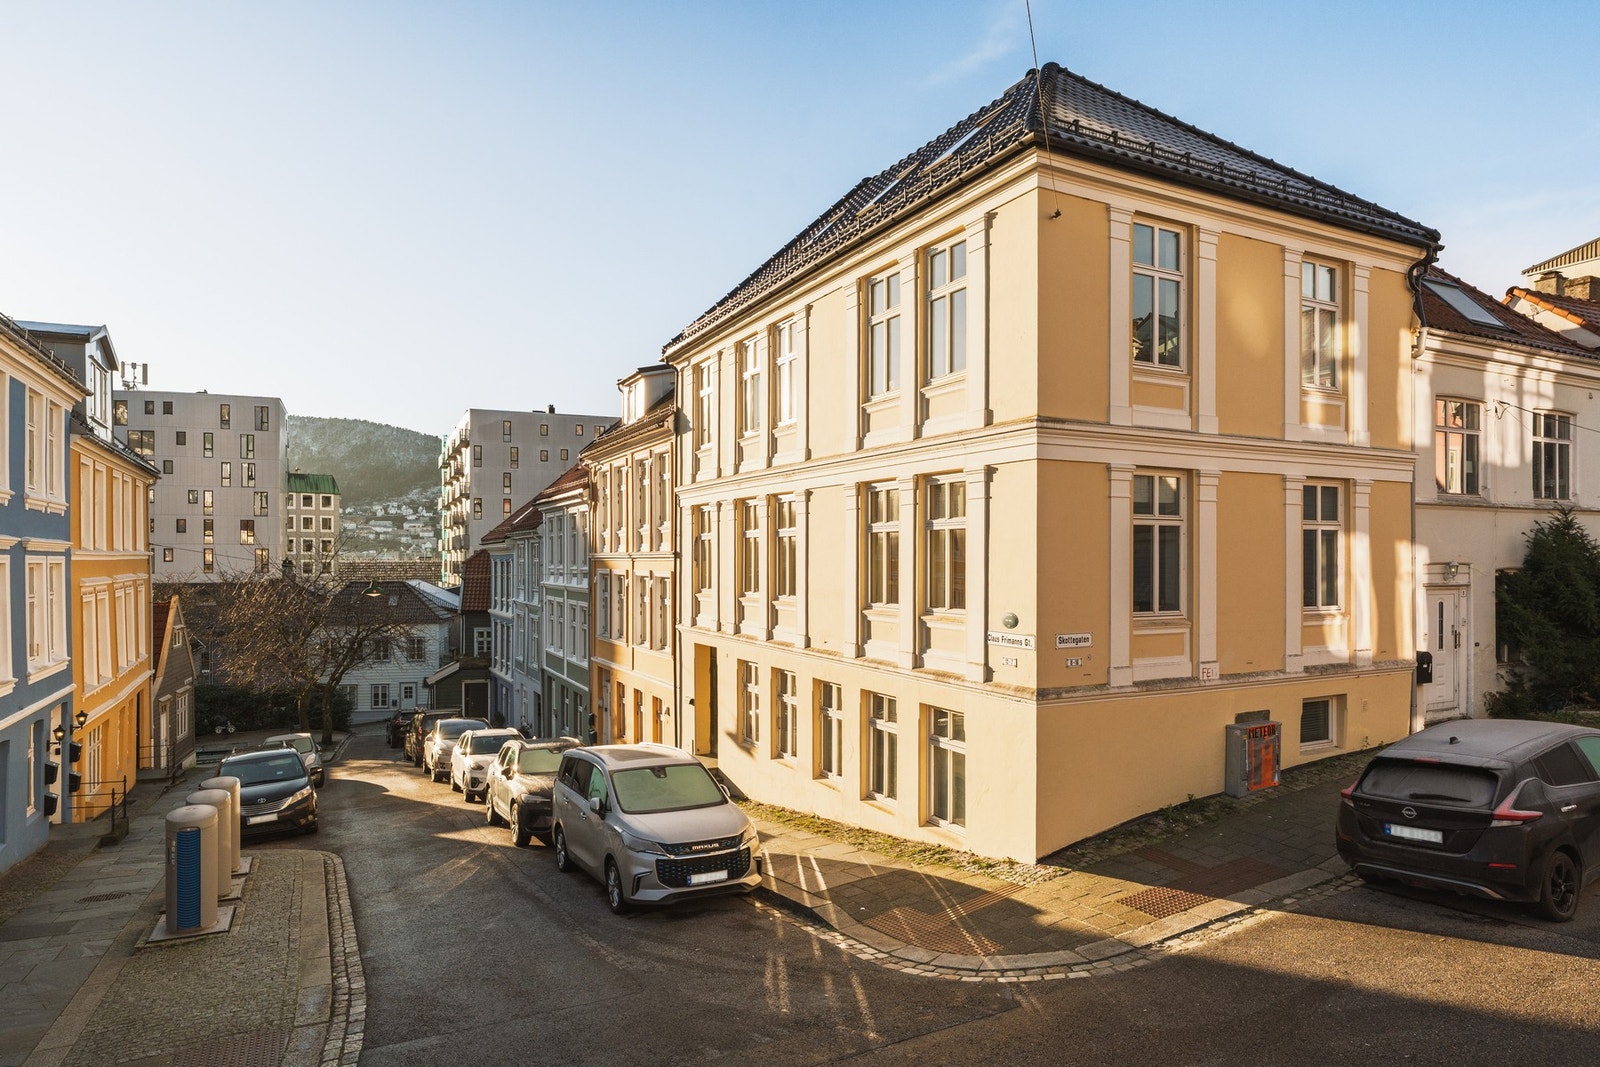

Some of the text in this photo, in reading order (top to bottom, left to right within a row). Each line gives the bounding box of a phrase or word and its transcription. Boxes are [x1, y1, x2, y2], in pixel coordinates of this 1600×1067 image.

[988, 634, 1000, 643] Claus
[1001, 636, 1022, 646] Frimanns
[1058, 636, 1090, 645] Skottegaten
